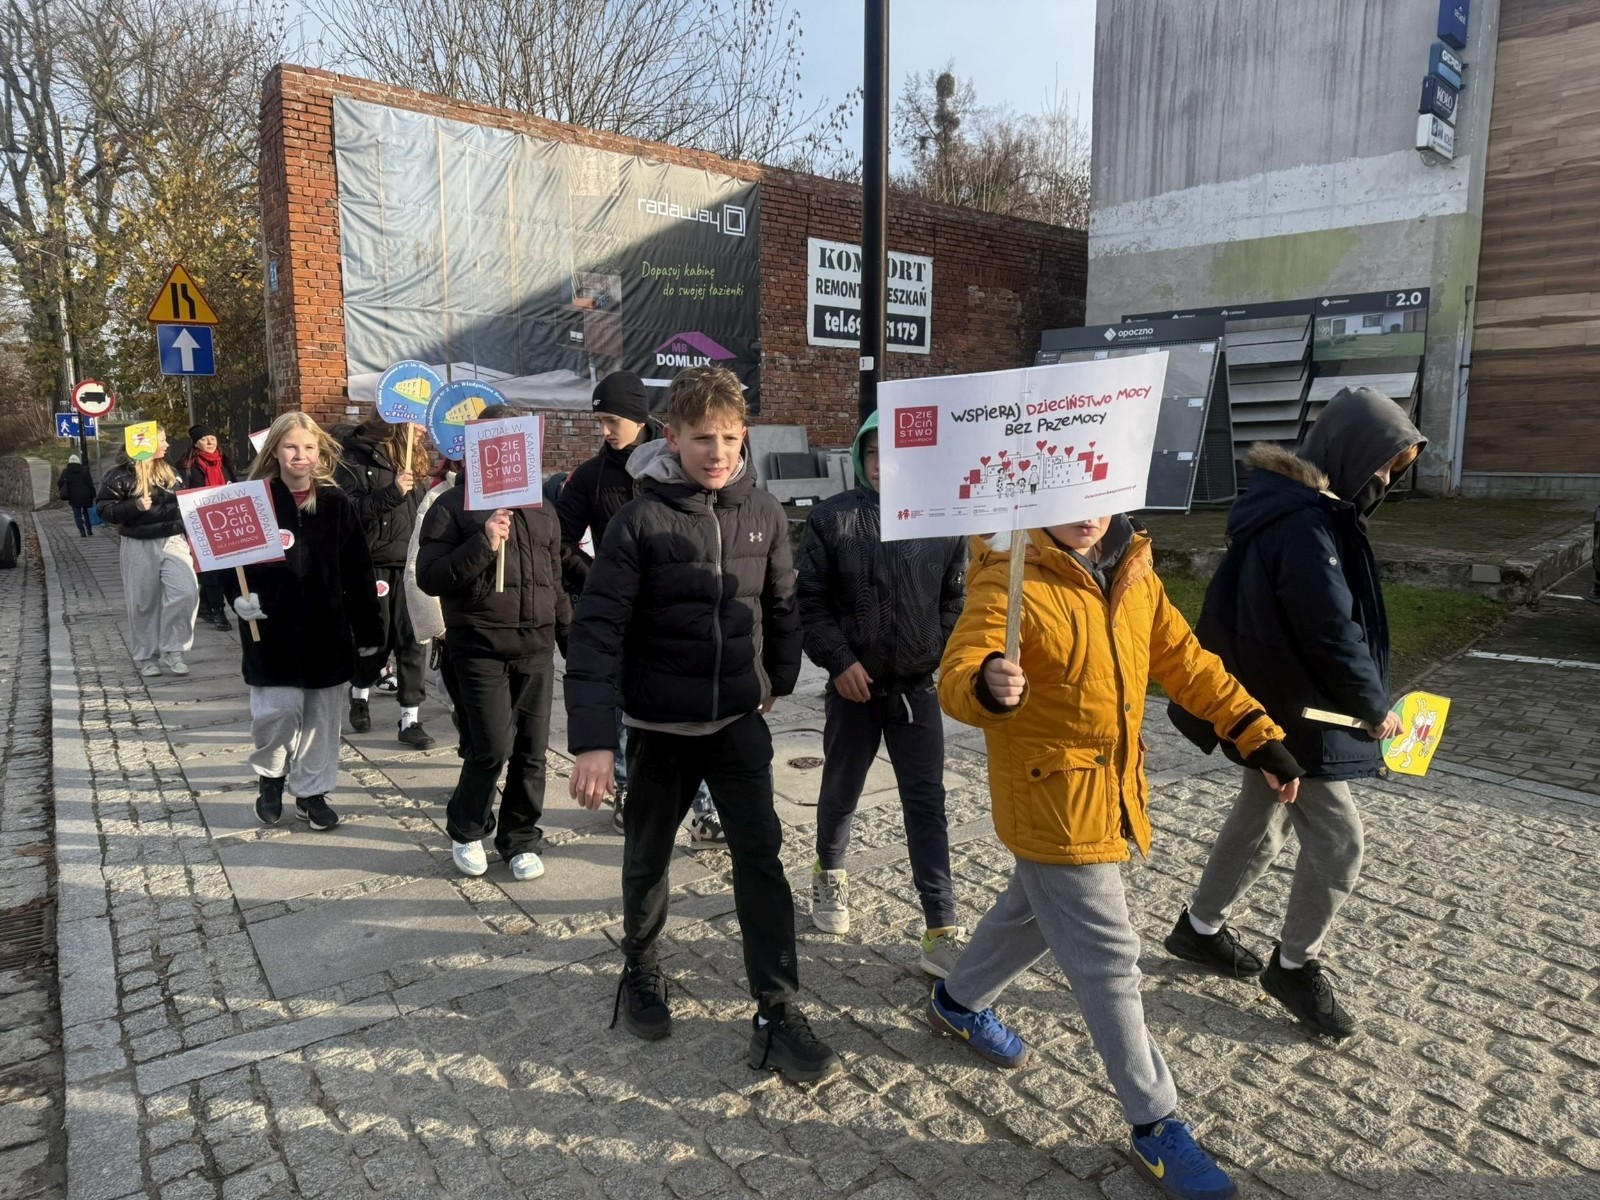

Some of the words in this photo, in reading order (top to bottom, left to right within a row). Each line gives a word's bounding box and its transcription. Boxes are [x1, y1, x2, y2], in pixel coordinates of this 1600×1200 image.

[637, 193, 721, 232] radaway
[642, 261, 682, 280] Dopasuj
[684, 262, 716, 280] kabinę
[663, 284, 675, 296] do
[678, 284, 706, 301] swojej
[708, 282, 744, 297] łazienki
[1396, 292, 1422, 307] 2.0
[1118, 328, 1154, 338] opoczno
[672, 342, 688, 353] MB
[656, 353, 712, 368] DOMLUX
[1116, 386, 1152, 401] MOCY
[478, 427, 510, 440] UDZIAŁ
[512, 424, 522, 432] W
[900, 428, 933, 438] STWO
[526, 432, 537, 485] KAMPANII
[470, 441, 482, 494] BIERZEMY
[486, 464, 522, 479] STWO
[194, 492, 234, 507] UDZIAŁ
[234, 488, 246, 496] W
[253, 495, 275, 542] KAMPANII
[187, 510, 212, 557] BIERZEMY
[214, 525, 256, 542] STWO
